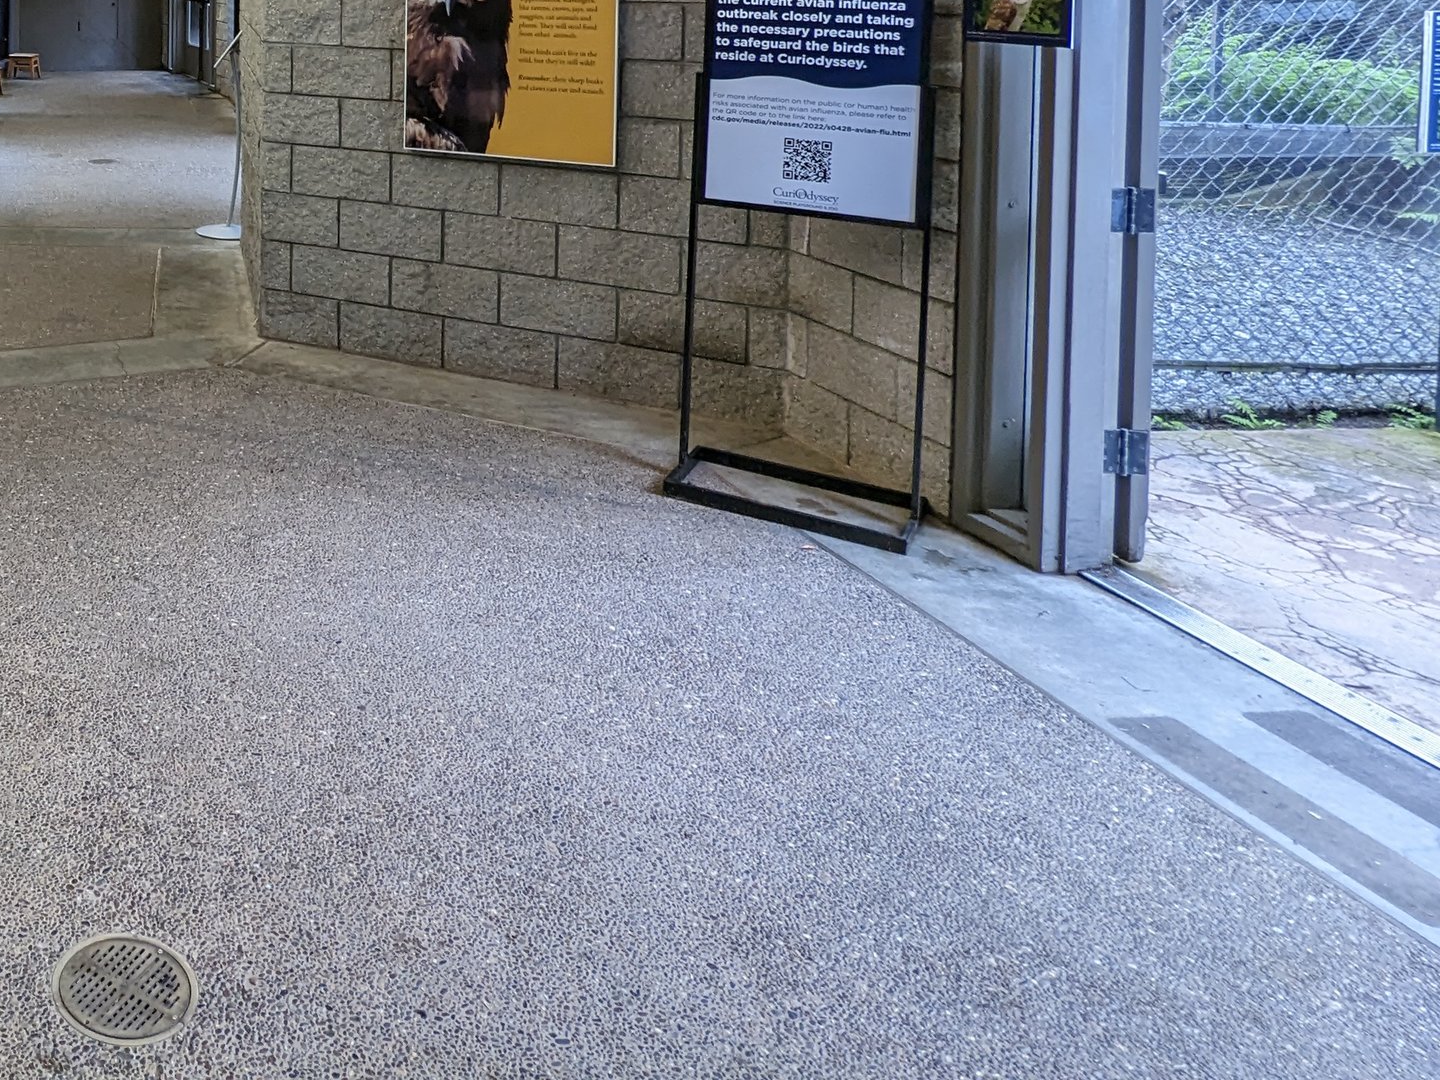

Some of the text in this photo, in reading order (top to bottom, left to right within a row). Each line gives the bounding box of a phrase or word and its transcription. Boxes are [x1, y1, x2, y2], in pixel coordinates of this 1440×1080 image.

[717, 9, 915, 28] outbreak closely and taking
[716, 22, 901, 41] the necessary precautions
[716, 36, 905, 56] to safeguard the birds that
[715, 50, 867, 70] reside at Curiodyssey.
[730, 101, 769, 110] associated
[788, 105, 809, 113] avian
[810, 106, 847, 116] influenza,
[848, 110, 875, 118] please
[876, 112, 896, 120] refer
[747, 94, 789, 104] information
[803, 98, 816, 106] the
[817, 99, 841, 108] public
[843, 102, 855, 110] (or
[857, 103, 888, 112] human)
[738, 109, 757, 117] code
[778, 112, 791, 120] the
[773, 187, 839, 204] CuriOdyssey
